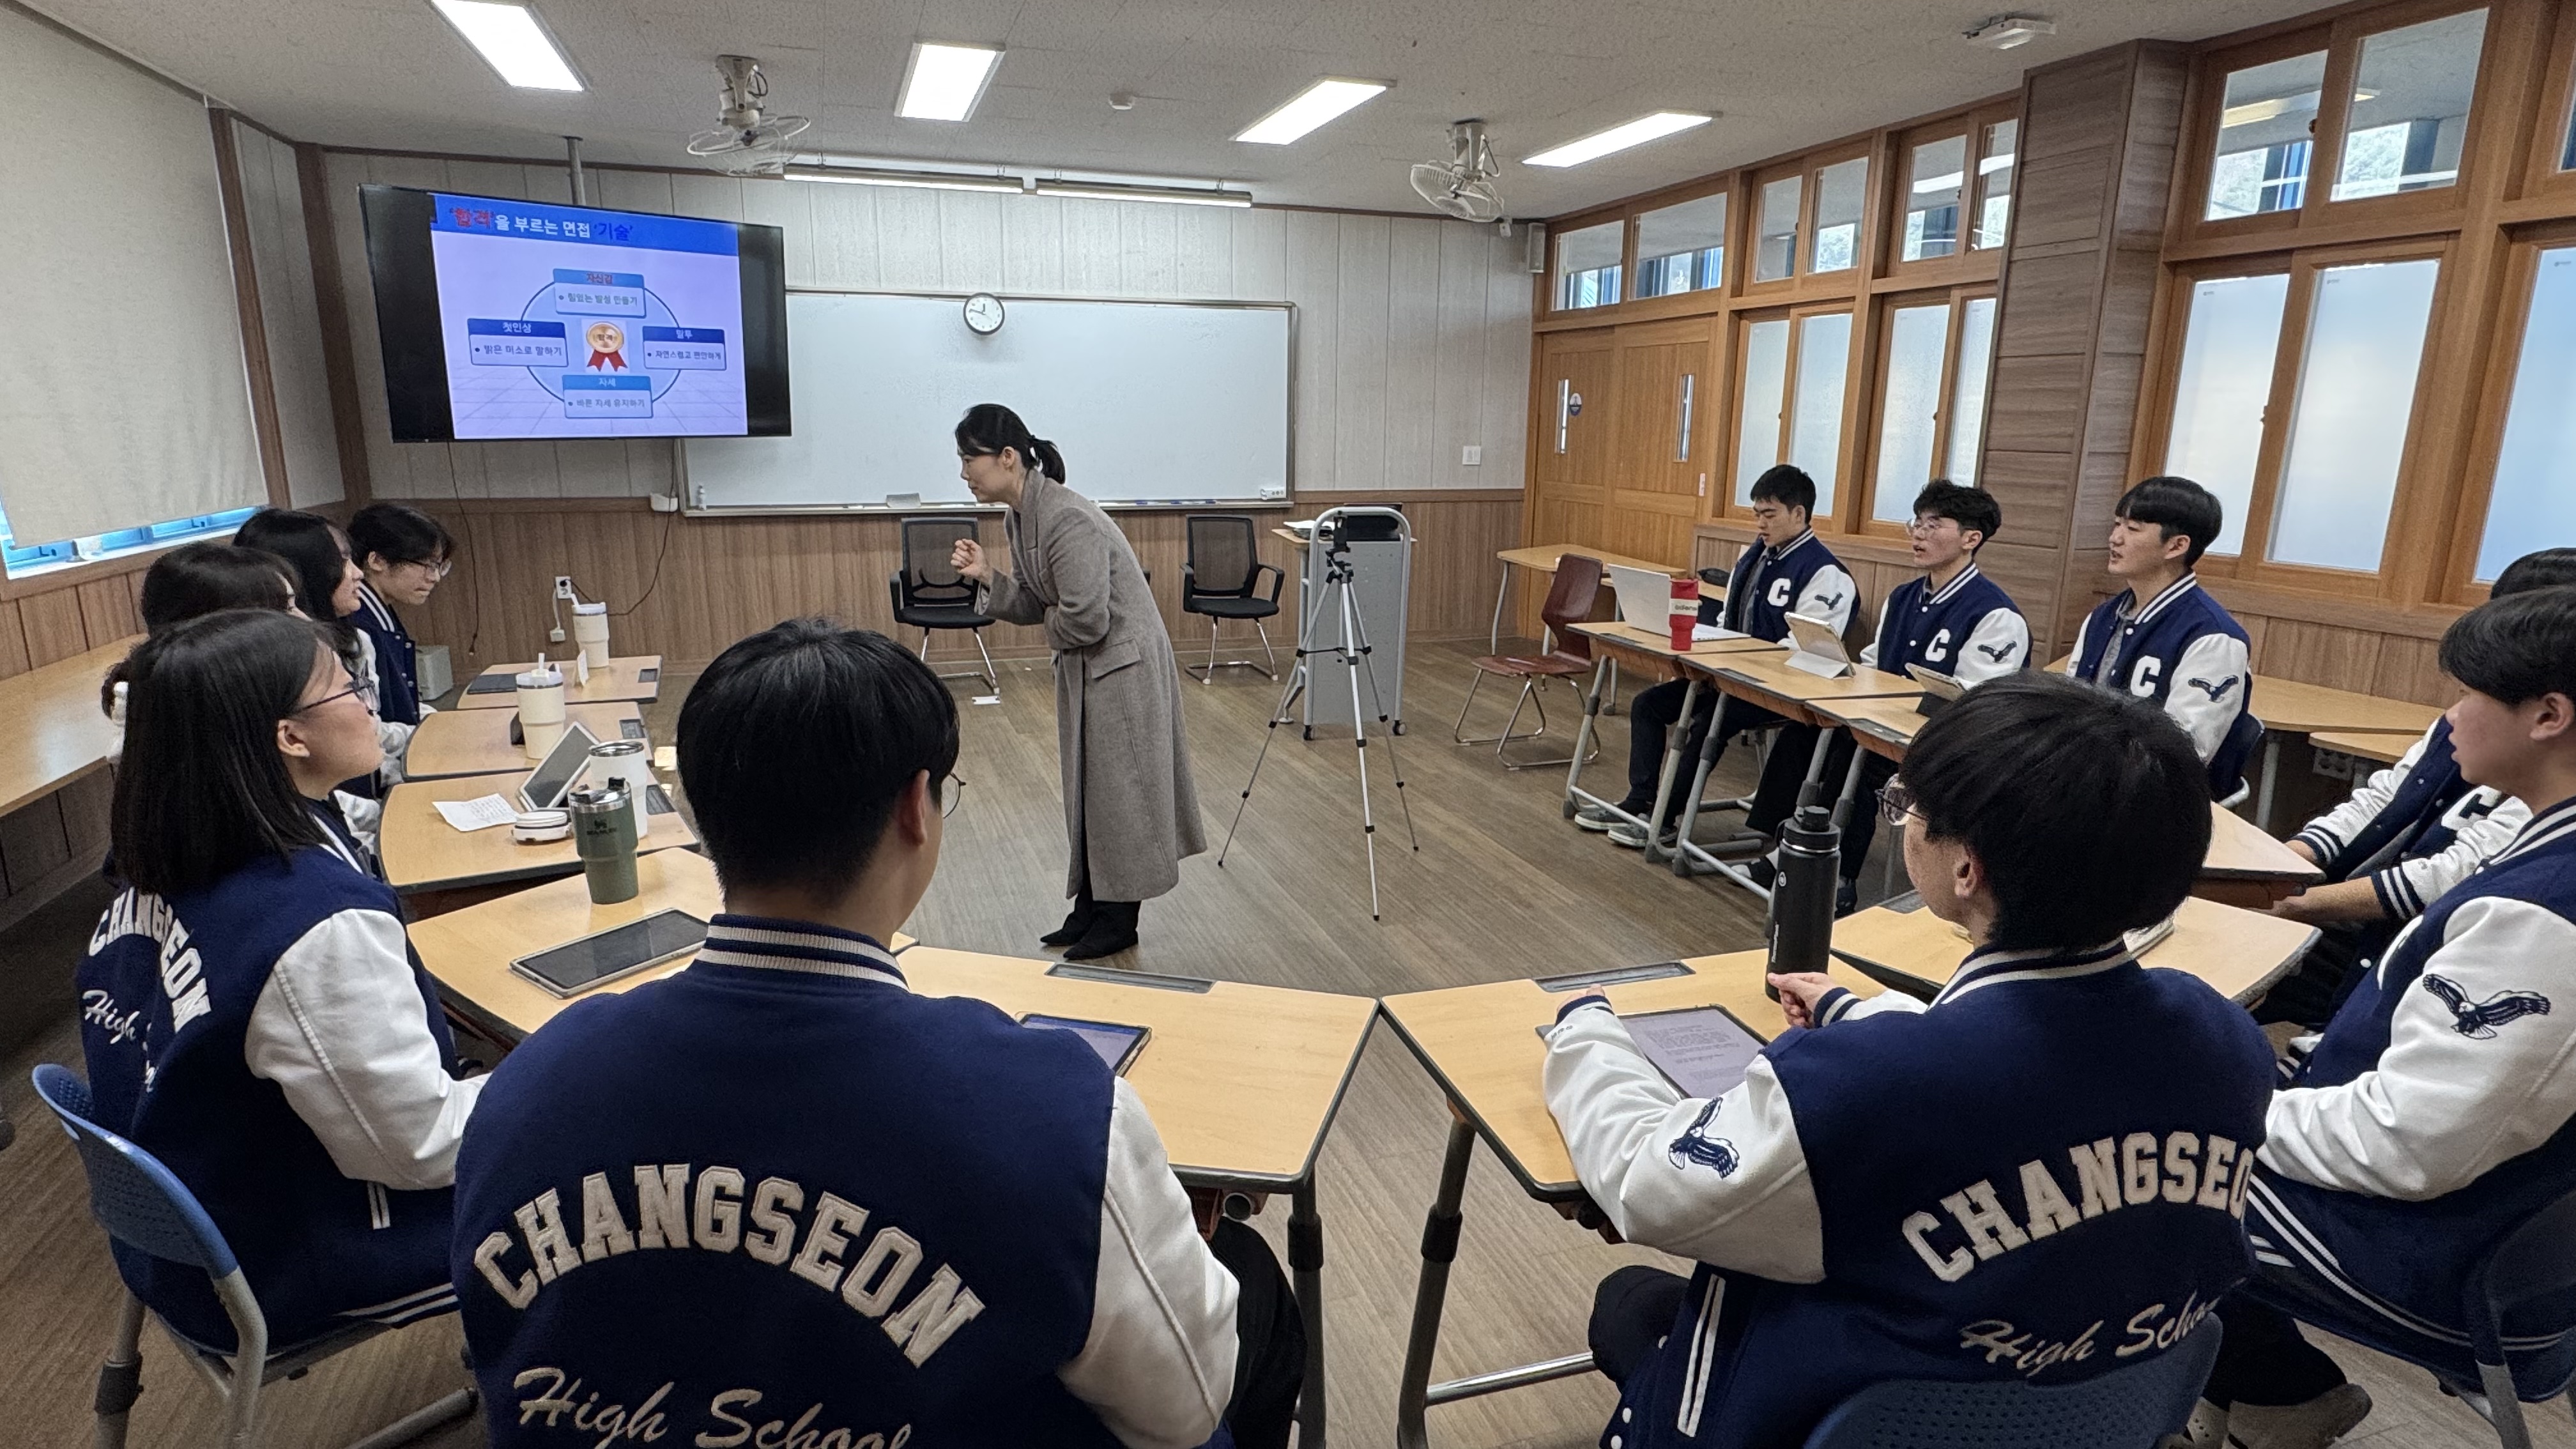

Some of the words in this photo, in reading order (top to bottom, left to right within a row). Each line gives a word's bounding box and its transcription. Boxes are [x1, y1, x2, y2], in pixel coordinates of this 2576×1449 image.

[514, 217, 558, 235] 부르는
[563, 221, 590, 238] 면접
[502, 322, 532, 334] 첫인상
[505, 345, 532, 355] 미소로
[1767, 578, 1791, 607] C
[1925, 629, 1951, 662] C
[2131, 655, 2161, 698] C
[82, 990, 140, 1044] High
[1902, 1131, 2253, 1282] CHANGSEO
[474, 1163, 986, 1368] CHANGSEON
[1960, 1320, 2104, 1376] High
[514, 1367, 674, 1449] High
